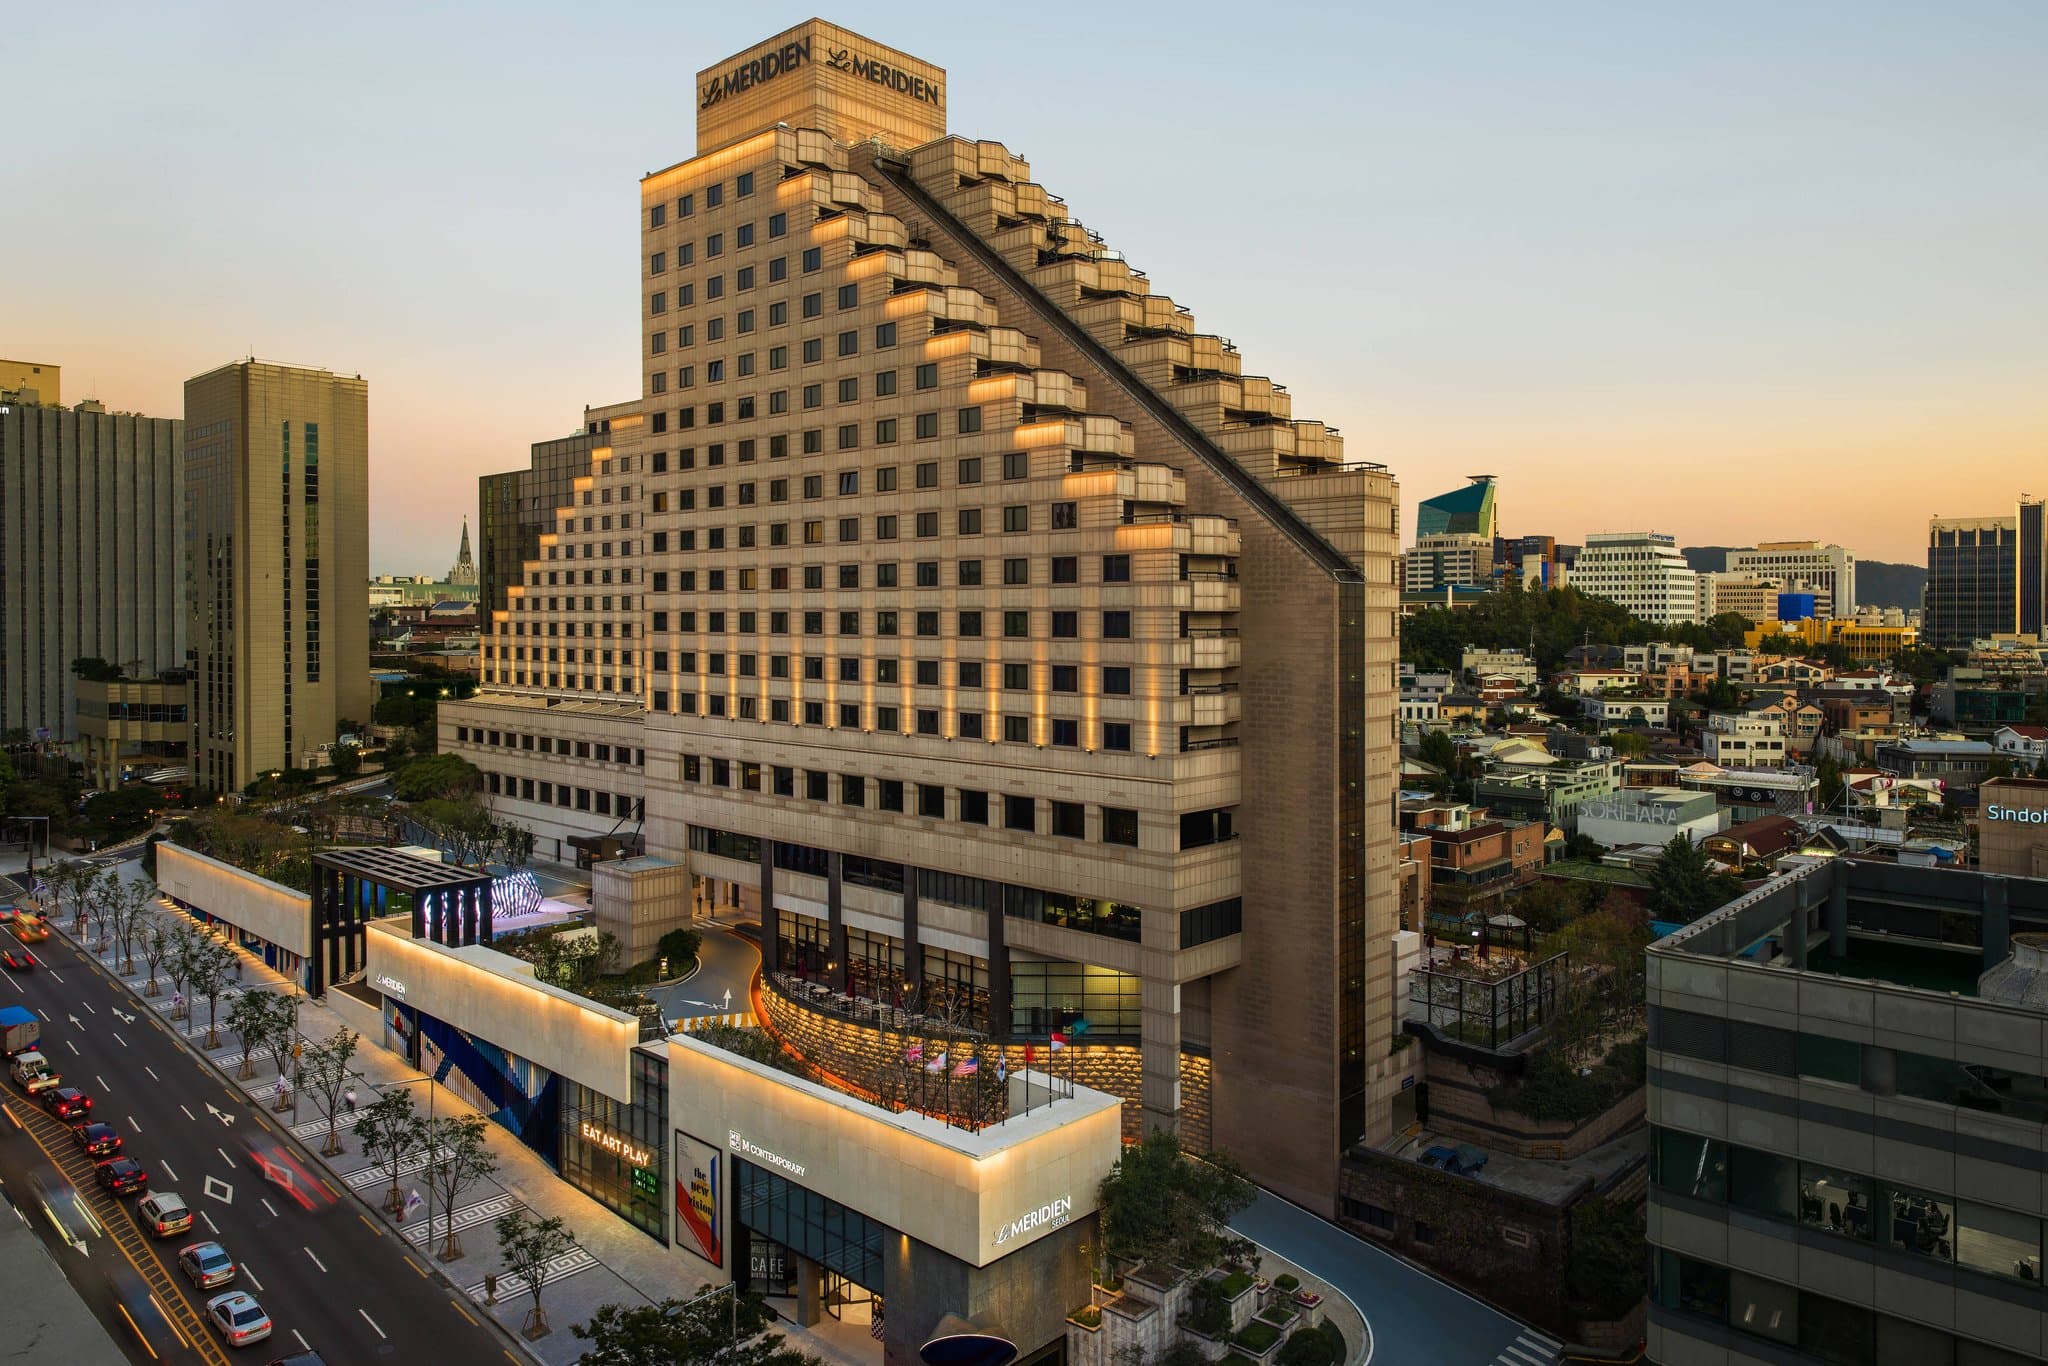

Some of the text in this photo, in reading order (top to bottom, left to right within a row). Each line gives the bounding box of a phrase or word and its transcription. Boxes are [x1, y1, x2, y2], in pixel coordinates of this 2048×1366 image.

[701, 36, 811, 108] Le MERIDIEN
[826, 47, 938, 105] Le MERIDIEN
[583, 1123, 649, 1166] EAT ART PLAY
[742, 1139, 750, 1151] M
[750, 1144, 806, 1177] CONTEMPORARY
[694, 1167, 707, 1180] the
[691, 1181, 709, 1197] new
[688, 1196, 713, 1216] vision
[1011, 1195, 1071, 1237] MERIDIEN
[1051, 1214, 1069, 1229] SEOUL
[751, 1256, 784, 1273] CAFE
